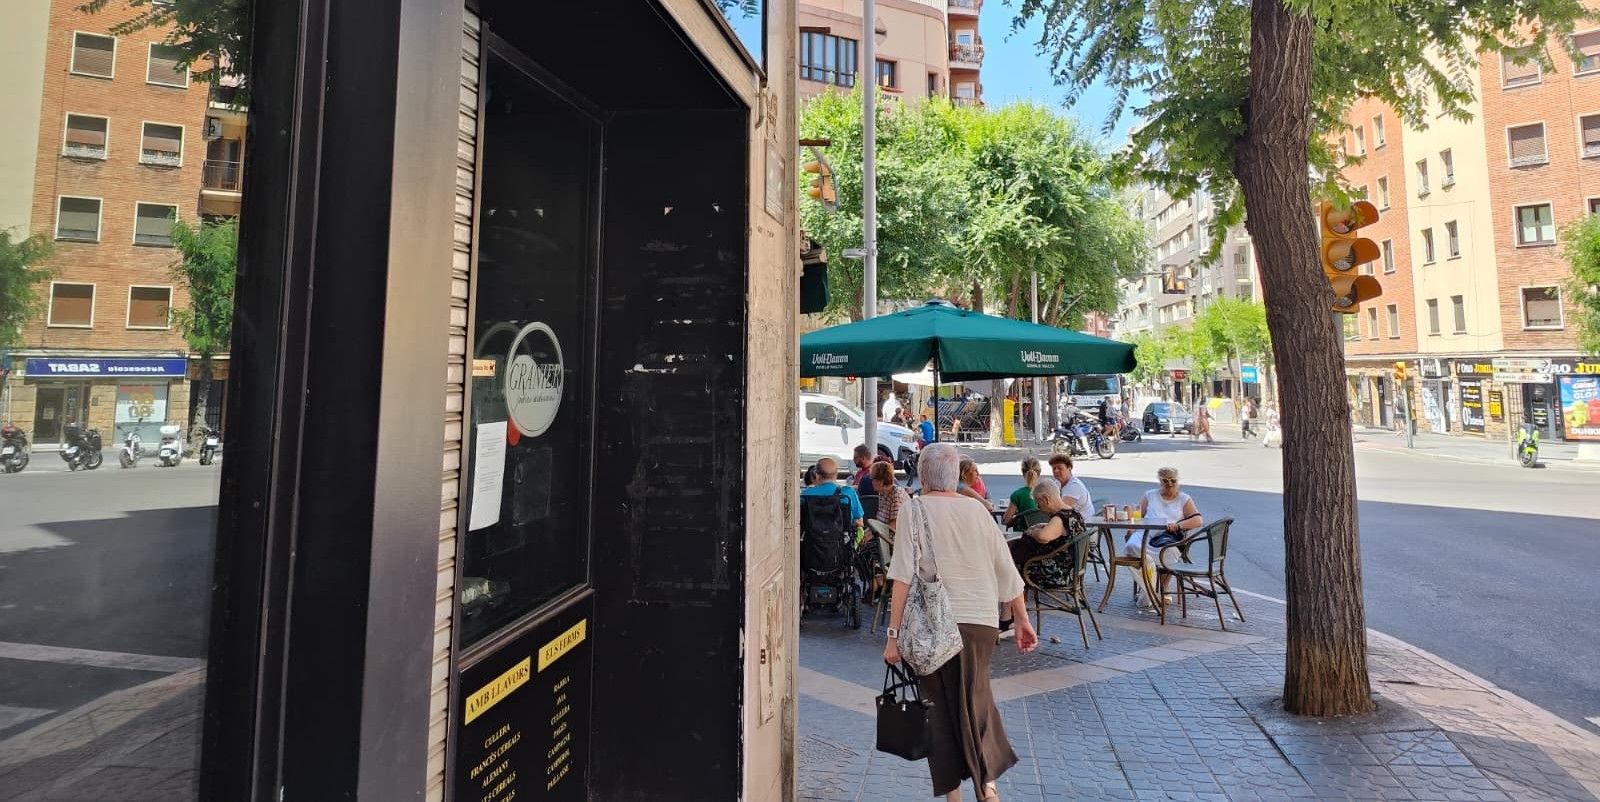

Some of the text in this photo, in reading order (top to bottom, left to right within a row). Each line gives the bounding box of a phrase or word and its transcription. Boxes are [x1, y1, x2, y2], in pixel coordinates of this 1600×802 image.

[1020, 350, 1060, 363] Voll-Damm
[510, 362, 561, 395] GRANIER
[545, 628, 580, 661] ELS FERMS
[469, 664, 529, 713] AMB LLAVORS
[497, 731, 521, 757] CEREALS
